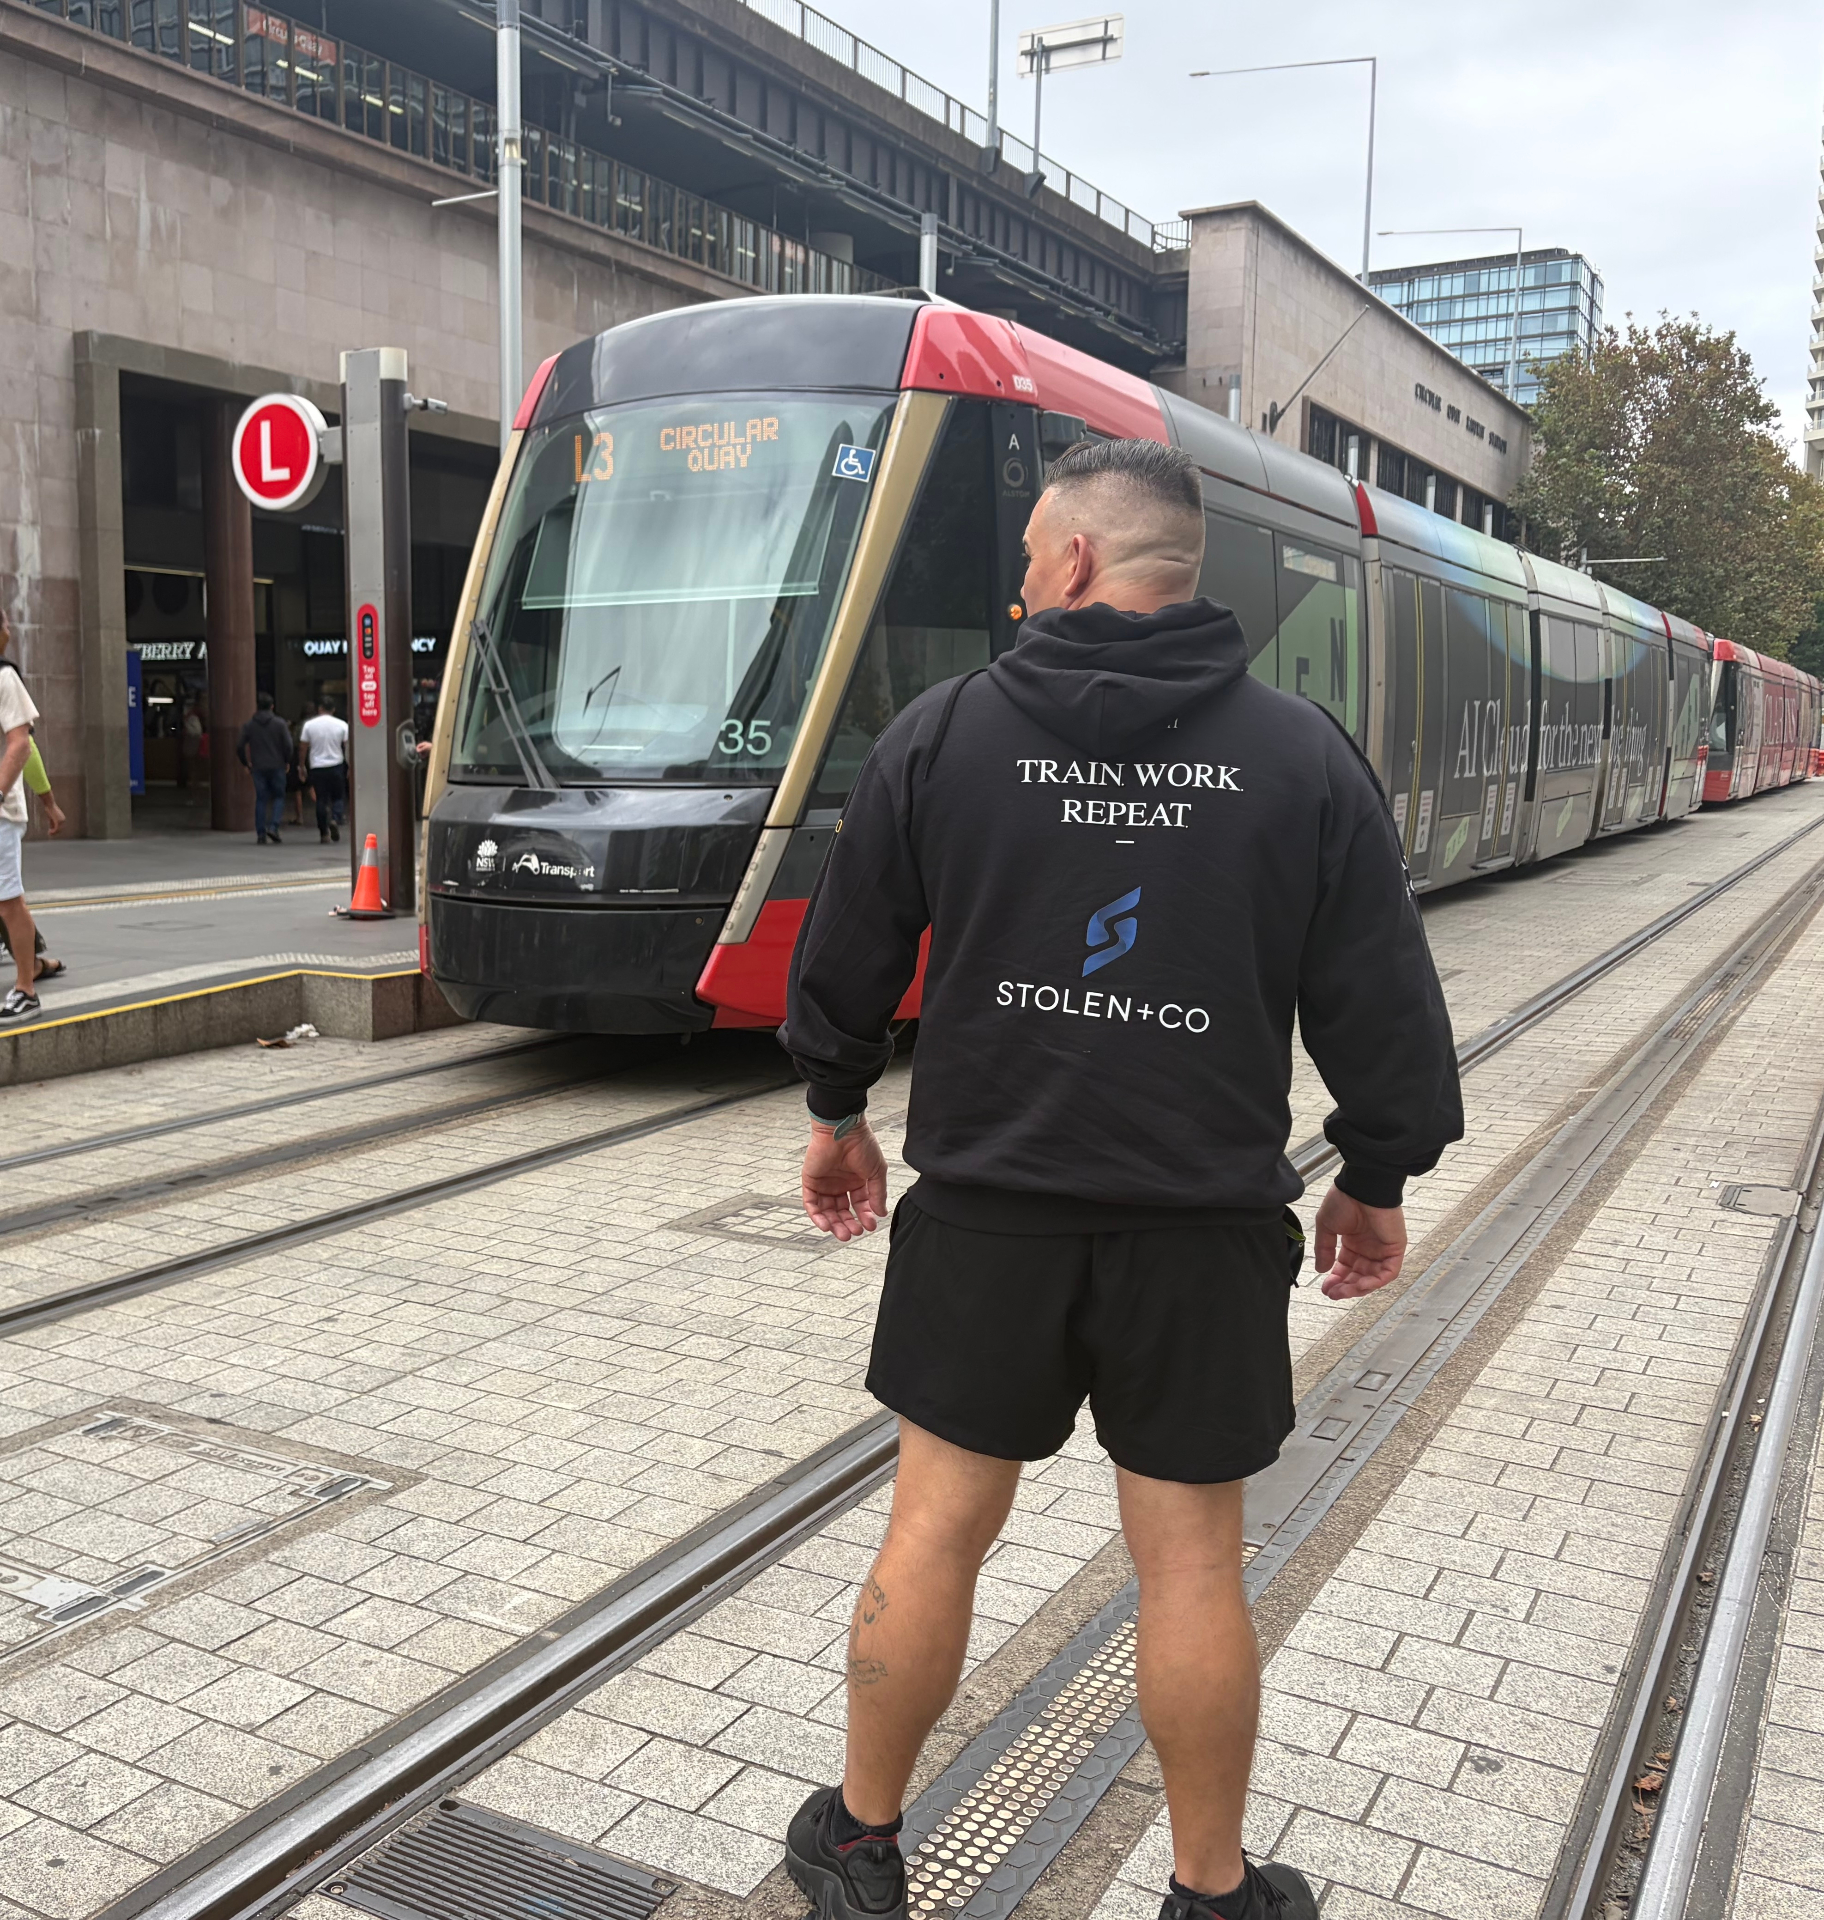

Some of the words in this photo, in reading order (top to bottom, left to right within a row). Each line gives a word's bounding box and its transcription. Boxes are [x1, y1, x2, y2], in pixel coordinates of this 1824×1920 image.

[260, 419, 291, 482] L
[574, 432, 614, 483] L3
[660, 416, 779, 451] CIRCULAR
[687, 443, 752, 472] QUAY
[1008, 433, 1020, 450] A
[303, 640, 341, 657] QUAY
[718, 718, 772, 755] 35
[1453, 699, 1481, 779] AI
[1537, 699, 1559, 770] for
[1578, 719, 1605, 765] next
[996, 980, 1211, 1034] STOLEN+CO
